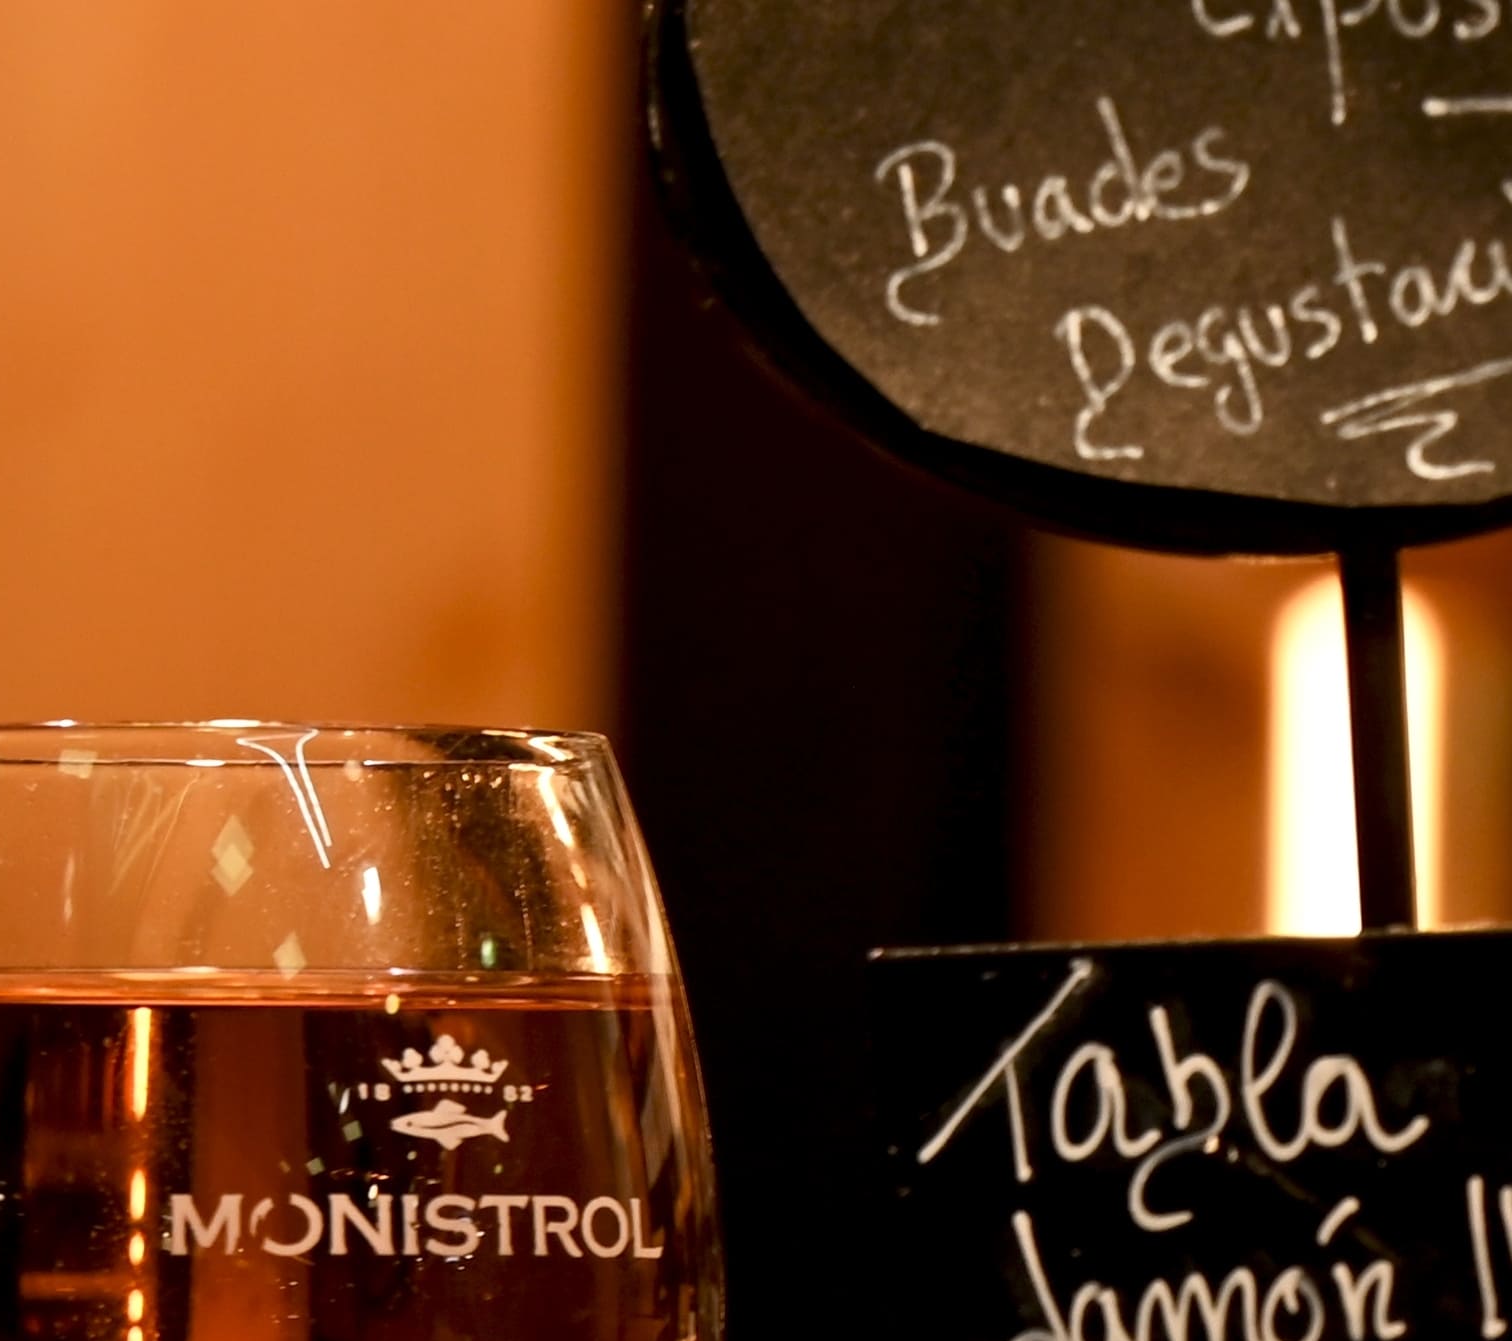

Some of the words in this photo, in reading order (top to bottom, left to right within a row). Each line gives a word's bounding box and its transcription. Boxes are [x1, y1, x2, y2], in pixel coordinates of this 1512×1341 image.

[874, 96, 1251, 328] Buades
[916, 958, 1430, 1232] Tabla
[166, 1193, 665, 1260] MONISTROL
